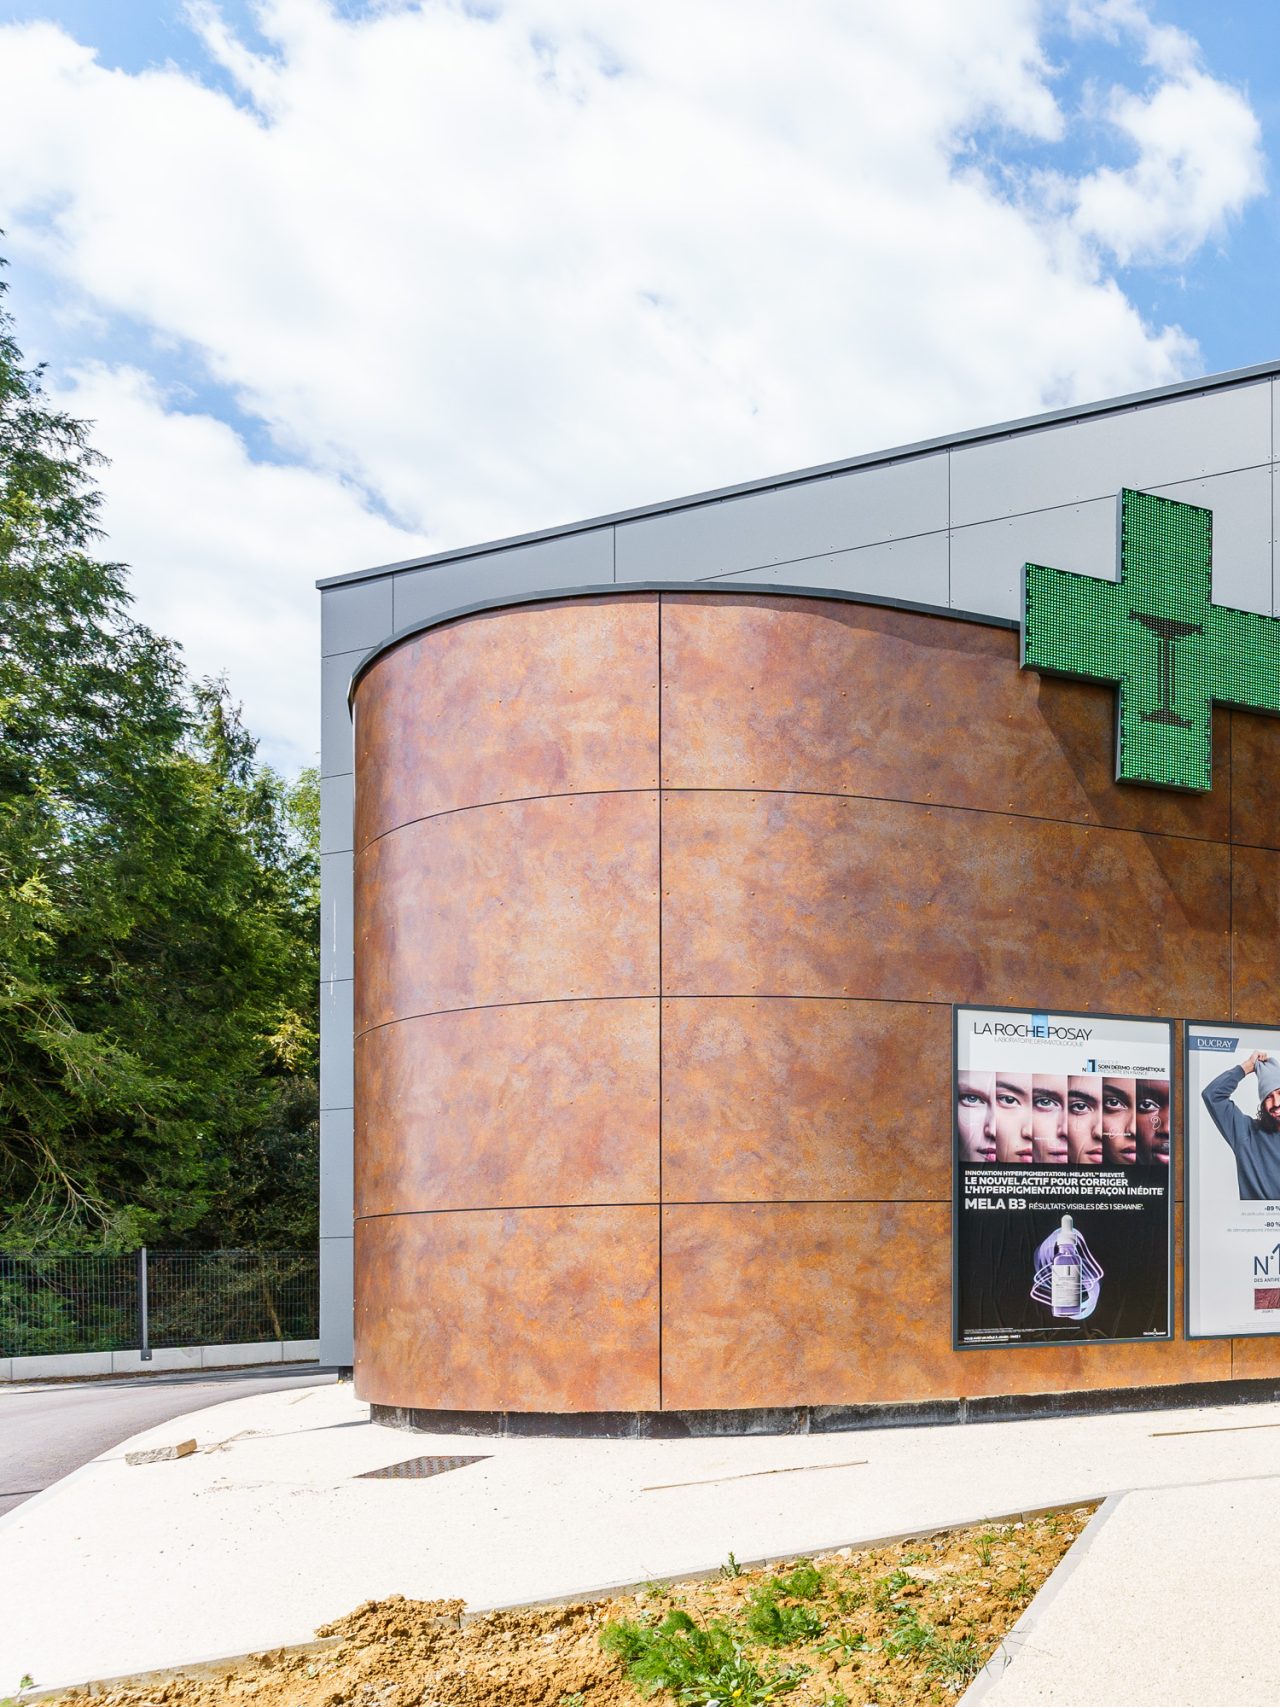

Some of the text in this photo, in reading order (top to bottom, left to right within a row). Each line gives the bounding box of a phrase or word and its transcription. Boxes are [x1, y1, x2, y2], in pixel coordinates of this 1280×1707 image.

[974, 1022, 1093, 1041] LA ROCHE POSAY
[1197, 1038, 1232, 1048] DUCRAY
[965, 1177, 1129, 1187] LE NOUVEL ACTIF POUR CORRIGER
[1080, 1186, 1093, 1195] DE
[1094, 1186, 1125, 1196] FAÇON
[965, 1198, 1006, 1210] MELA
[1008, 1198, 1026, 1210] B3
[1028, 1202, 1066, 1210] RÉSULTATS
[1095, 1202, 1108, 1210] DÈS
